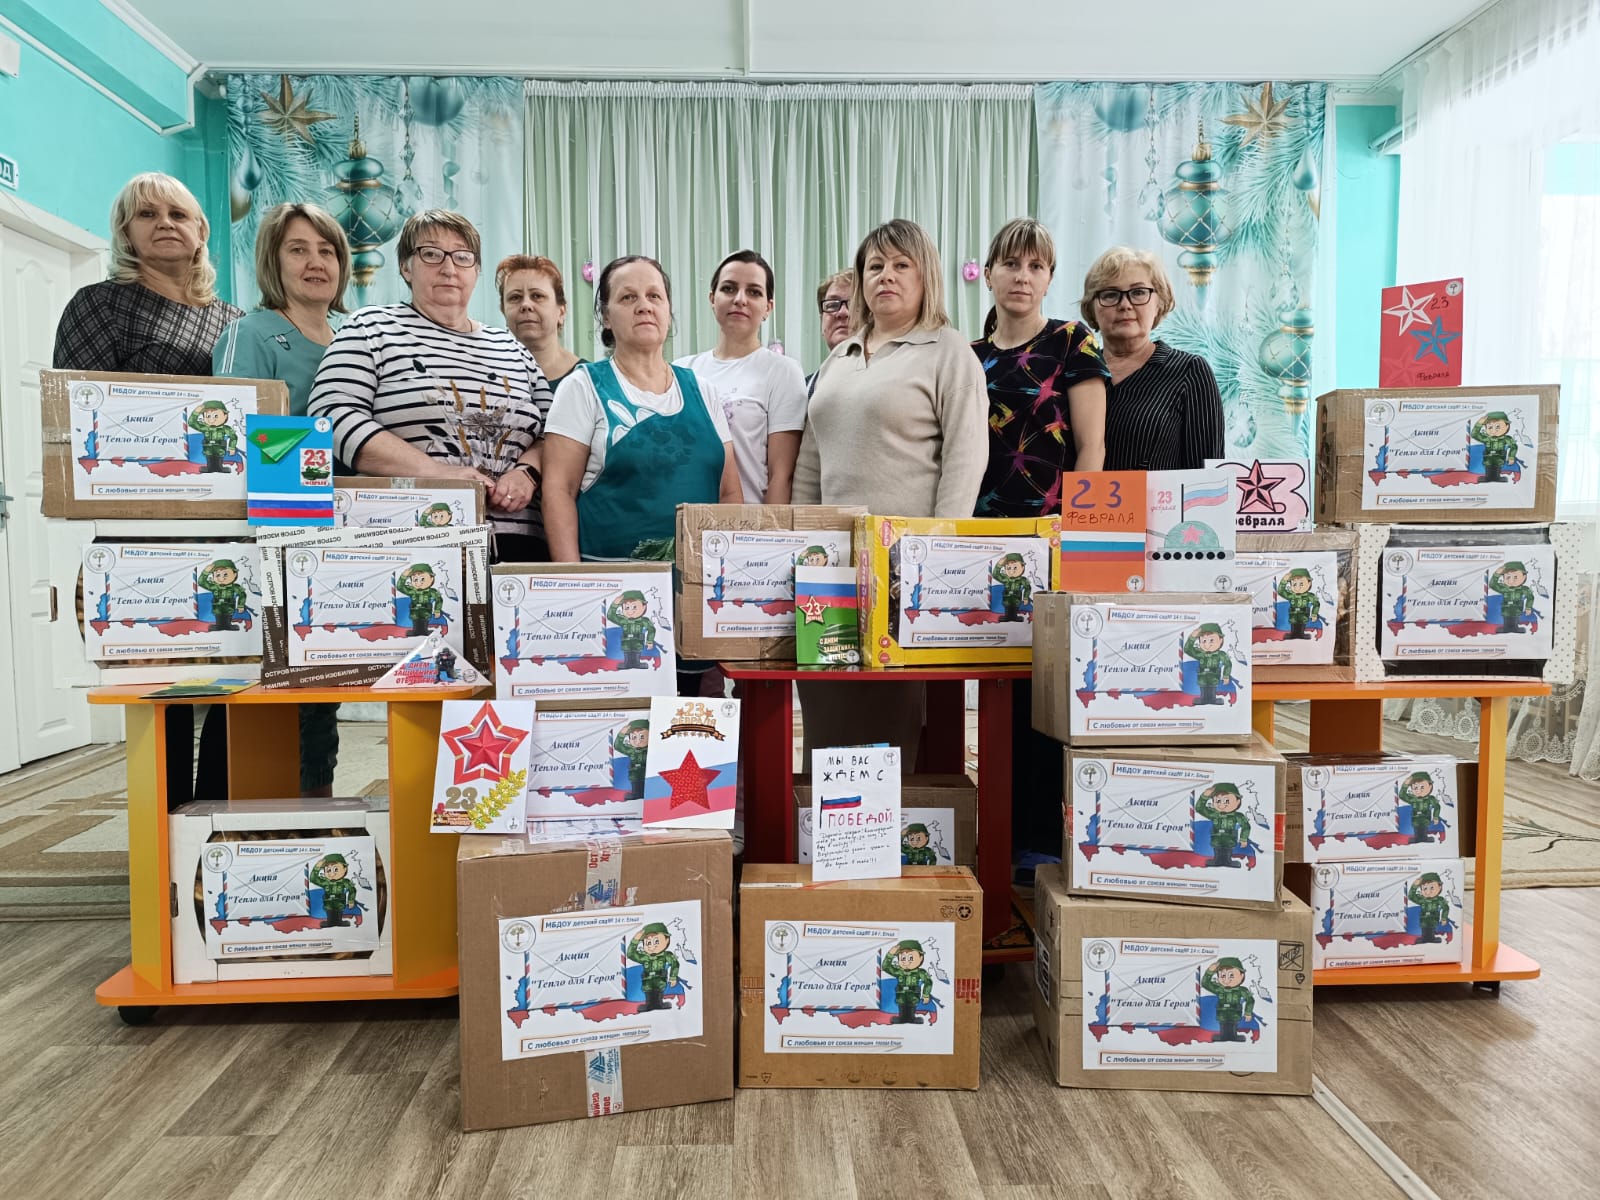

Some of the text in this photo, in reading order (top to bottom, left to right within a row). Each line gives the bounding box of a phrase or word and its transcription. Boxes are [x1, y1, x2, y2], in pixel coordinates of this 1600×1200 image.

[1431, 297, 1449, 310] 23
[121, 414, 153, 423] Акция
[1410, 428, 1439, 437] Акция
[99, 435, 184, 444] "Тепло для Героя"
[1389, 448, 1419, 456] "Тепло
[1435, 447, 1465, 456] Героя"
[304, 449, 326, 466] 23
[1158, 491, 1172, 504] 23
[366, 516, 391, 524] Акция
[1236, 515, 1285, 528] евраля
[281, 529, 305, 537] ОСТРОВ
[354, 529, 388, 539] ИЗОБИЛИЯ
[426, 532, 449, 541] ОСТРОВ
[317, 536, 341, 545] ОСТРОВ
[392, 536, 426, 545] ИЗОБИЛИЯ
[743, 560, 768, 568] Акция
[940, 567, 965, 575] Акция
[133, 575, 164, 584] Акция
[334, 580, 364, 589] Акция
[765, 578, 791, 586] Героя"
[1428, 578, 1456, 587] Акция
[962, 587, 988, 595] Героя"
[111, 595, 194, 605] "Тепло для Героя"
[313, 601, 345, 609] "Тепло
[361, 600, 392, 609] Героя"
[1407, 598, 1437, 606] "Тепло
[1453, 597, 1483, 606] Героя"
[542, 608, 573, 619] Акция
[806, 603, 821, 615] 23
[520, 630, 602, 641] "Тепло для Героя"
[1120, 641, 1150, 651] Акция
[265, 668, 290, 678] ОСТРОВ
[1098, 664, 1179, 674] "Тепло для Героя"
[300, 668, 359, 683] ОСТРОВ ИЗОБИЛИЯ
[684, 702, 705, 717] 23
[549, 739, 580, 750] Акция
[561, 762, 575, 771] для
[577, 760, 609, 771] Героя"
[826, 755, 869, 766] МЫ ВАС
[876, 770, 884, 781] С
[445, 786, 477, 810] 23
[1344, 790, 1370, 800] Акция
[1125, 796, 1158, 807] Акция
[1326, 808, 1395, 820] "Тепло для Героя"
[1101, 819, 1190, 833] "Тепло для Героя"
[248, 872, 278, 883] Акция
[228, 892, 306, 904] "Тепло для Героя"
[1353, 890, 1379, 900] Акция
[1334, 909, 1404, 920] "Тепло для Героя"
[545, 919, 570, 929] МБДОУ
[572, 917, 597, 927] детский
[555, 949, 589, 963] Акция
[815, 957, 846, 967] Акция
[531, 970, 621, 990] "Тепло для Героя"
[1133, 975, 1165, 984] Акция
[792, 981, 876, 991] "Тепло для Героя"
[1110, 999, 1196, 1009] "Тепло для Героя"
[527, 1042, 533, 1050] С
[535, 1038, 569, 1048] любовью
